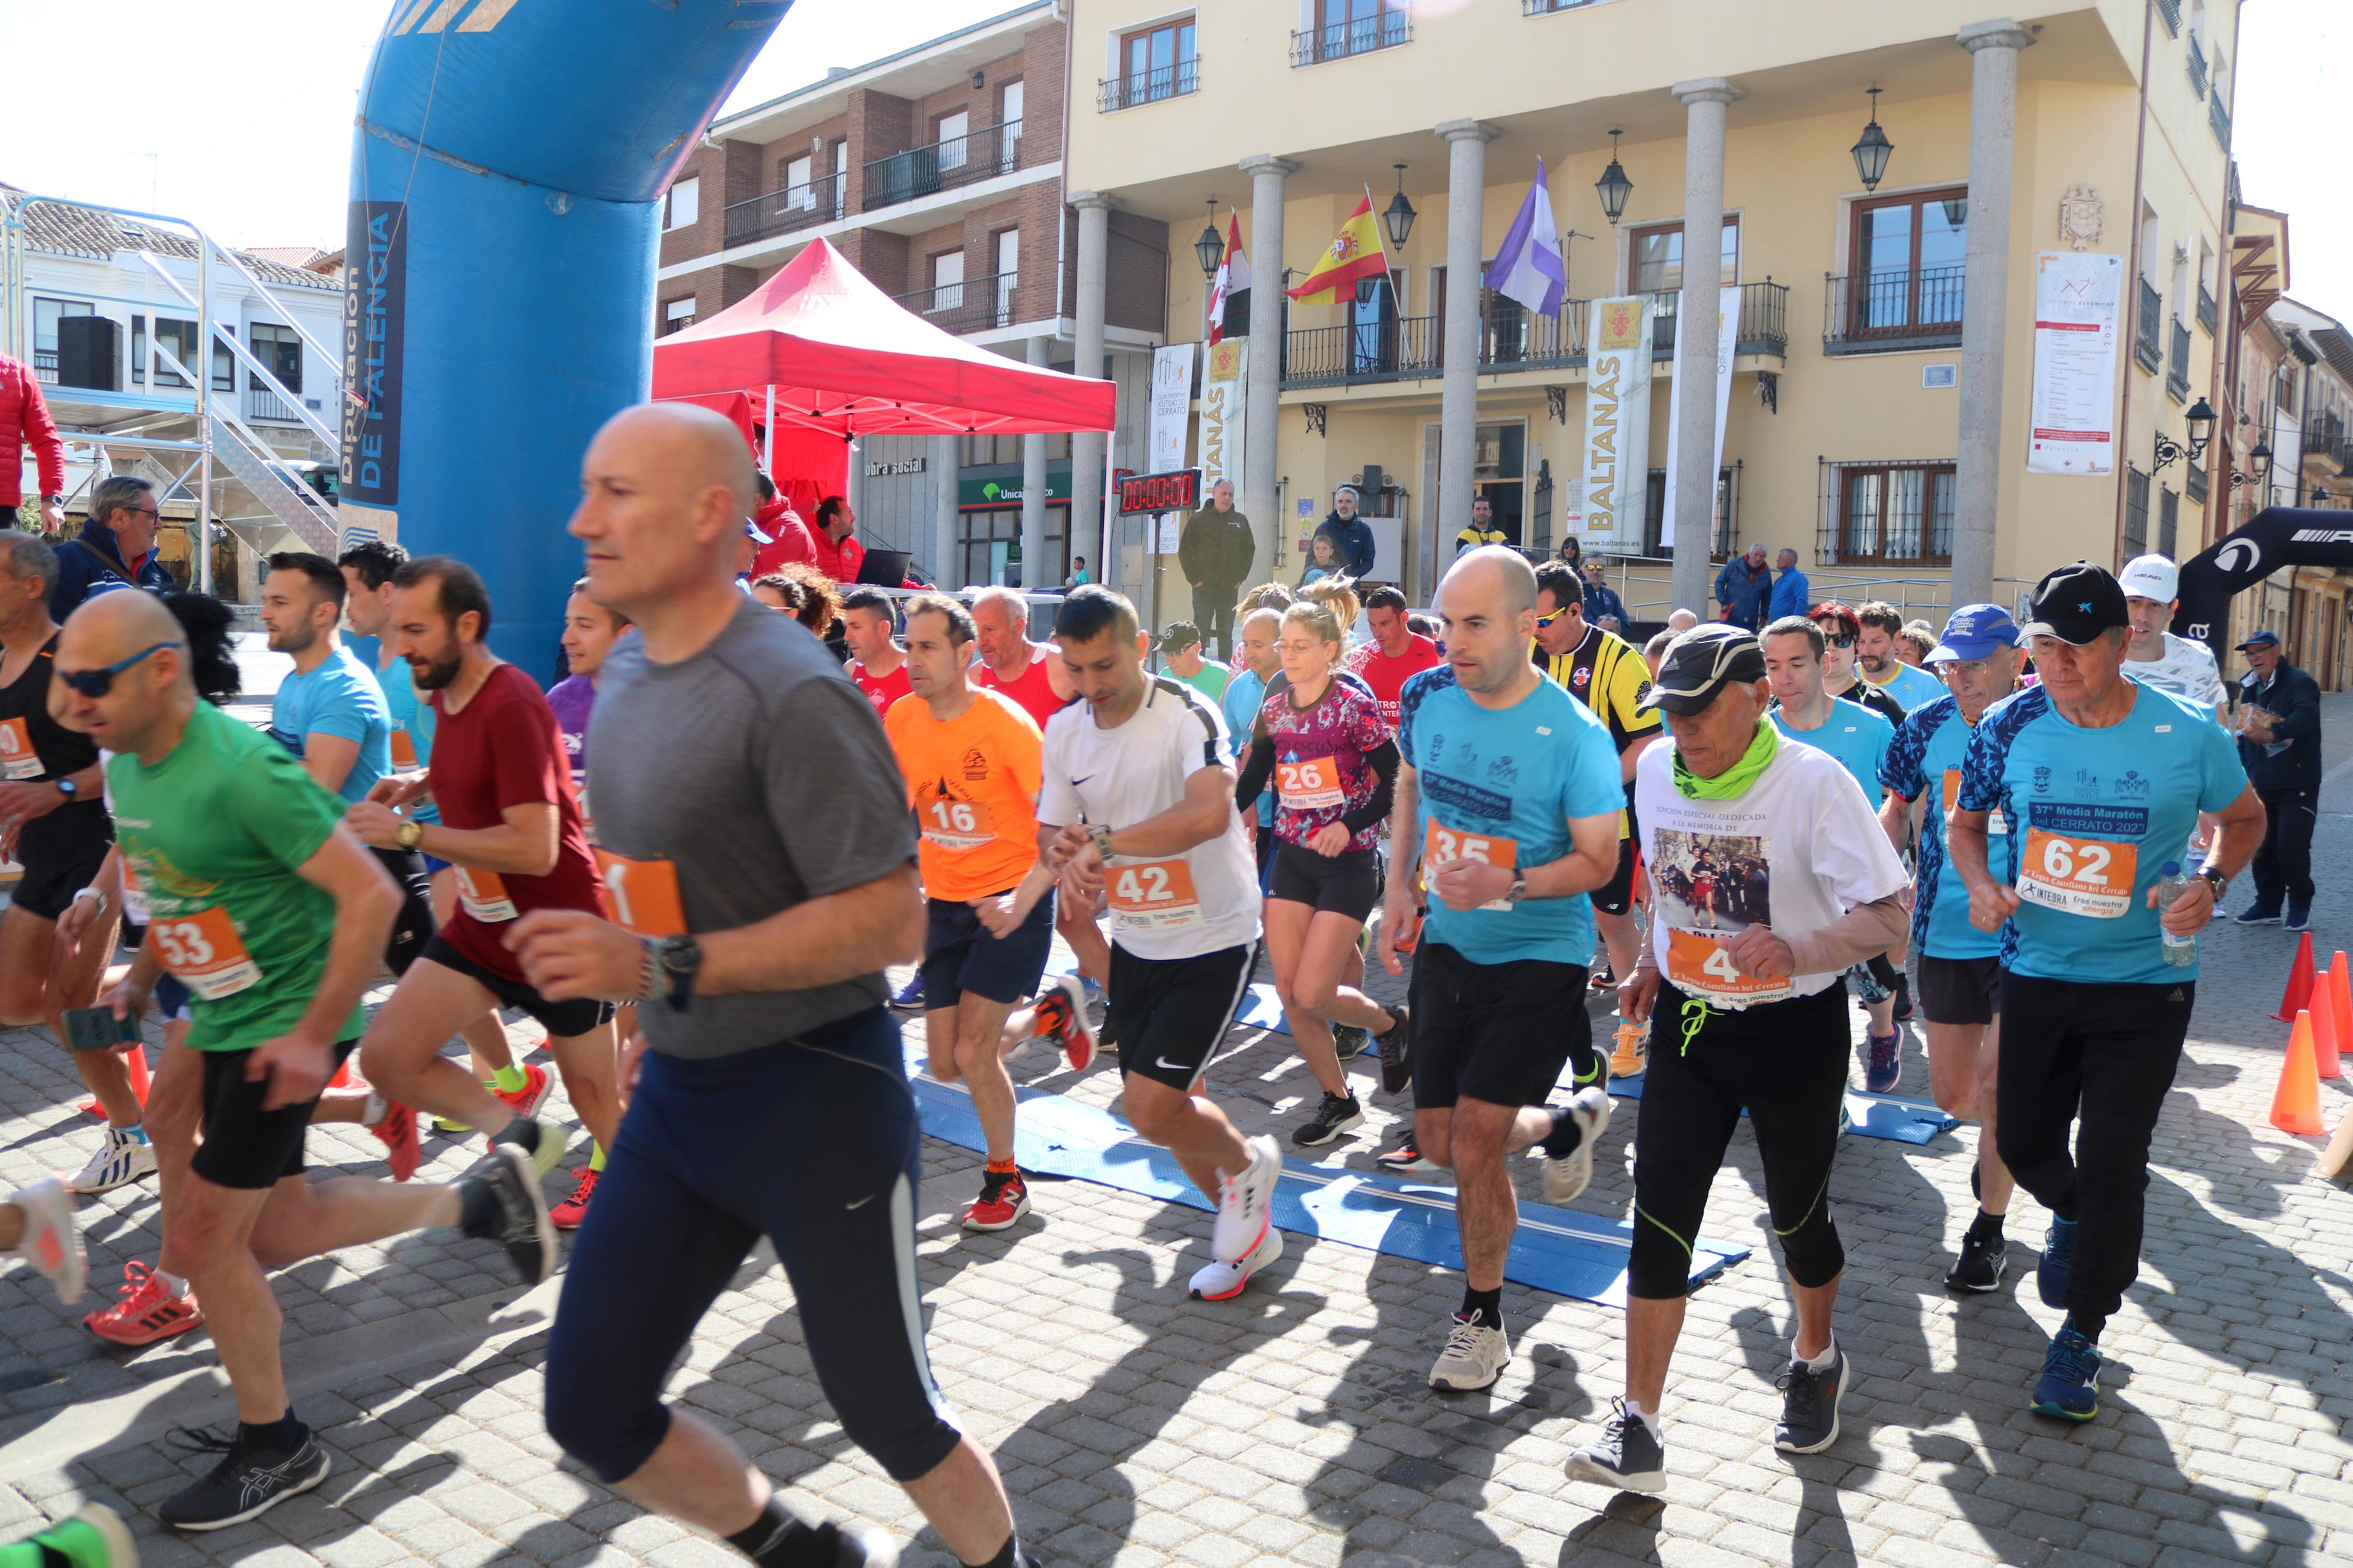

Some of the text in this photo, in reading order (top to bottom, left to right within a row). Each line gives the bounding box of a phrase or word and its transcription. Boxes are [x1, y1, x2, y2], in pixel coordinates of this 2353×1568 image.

[2103, 317, 2112, 346] 2023
[361, 212, 389, 489] DE PALENCIA
[342, 267, 359, 484] Diputación
[1158, 407, 1186, 416] CERRATO
[1588, 357, 1620, 531] BALTANÁS
[865, 458, 922, 476] obra social
[1280, 764, 1322, 790] 26
[931, 801, 975, 832] 16
[1657, 806, 1681, 815] EDICION
[1684, 810, 1715, 819] ESPECIAL
[2033, 817, 2145, 833] del CERRATO 2023
[2056, 806, 2091, 817] Media
[2095, 808, 2143, 820] Maratón
[1688, 823, 1722, 831] MEMORIA
[1434, 830, 1490, 865] 35
[2044, 839, 2111, 885] 62
[1116, 867, 1174, 902] 42
[2031, 870, 2049, 883] Legua
[2051, 877, 2086, 891] Castellana
[2101, 886, 2128, 895] Cerrato
[2073, 896, 2089, 905] Eres
[2092, 899, 2122, 908] nuestra
[155, 923, 214, 966] 53
[1703, 948, 1740, 983] 4
[1702, 982, 1740, 991] Castellana
[1755, 981, 1786, 990] Cerrato
[1750, 993, 1783, 1002] nuestra
